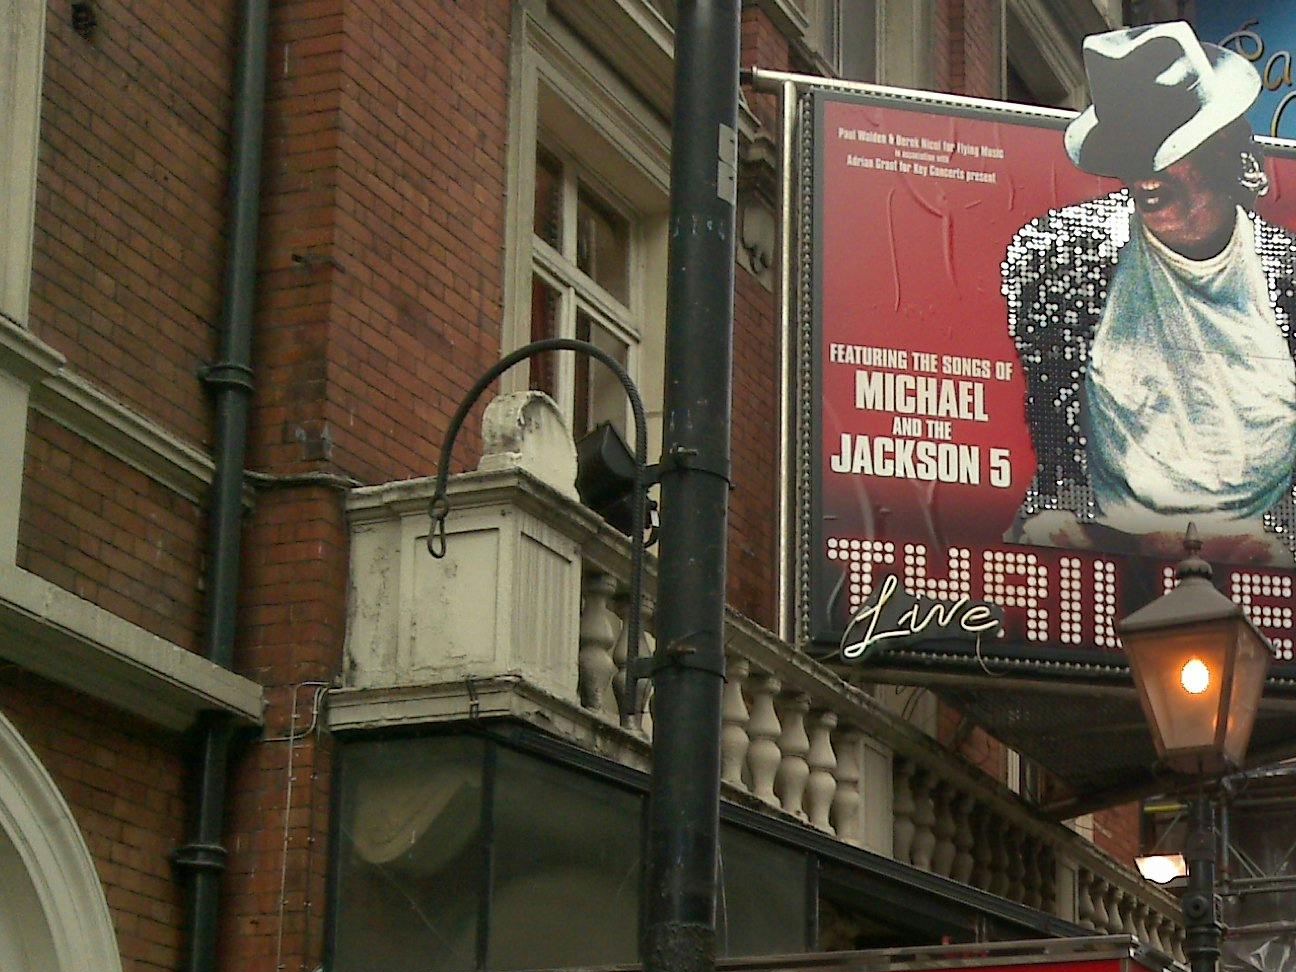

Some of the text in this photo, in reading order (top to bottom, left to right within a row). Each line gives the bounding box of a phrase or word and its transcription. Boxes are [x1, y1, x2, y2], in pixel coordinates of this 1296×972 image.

[838, 127, 856, 141] Paul
[889, 133, 896, 145] &
[896, 134, 920, 149] Derek
[943, 140, 956, 153] for
[957, 142, 979, 158] Flying
[981, 145, 1004, 160] Music
[847, 154, 997, 184] Adrian Grant for Key Concerts present
[829, 343, 1013, 381] FEATURING THE SONGS OF
[855, 369, 989, 422] MICHAEL
[892, 416, 952, 441] AND THE
[830, 433, 1012, 488] JACKSON 5
[842, 574, 999, 659] Live
